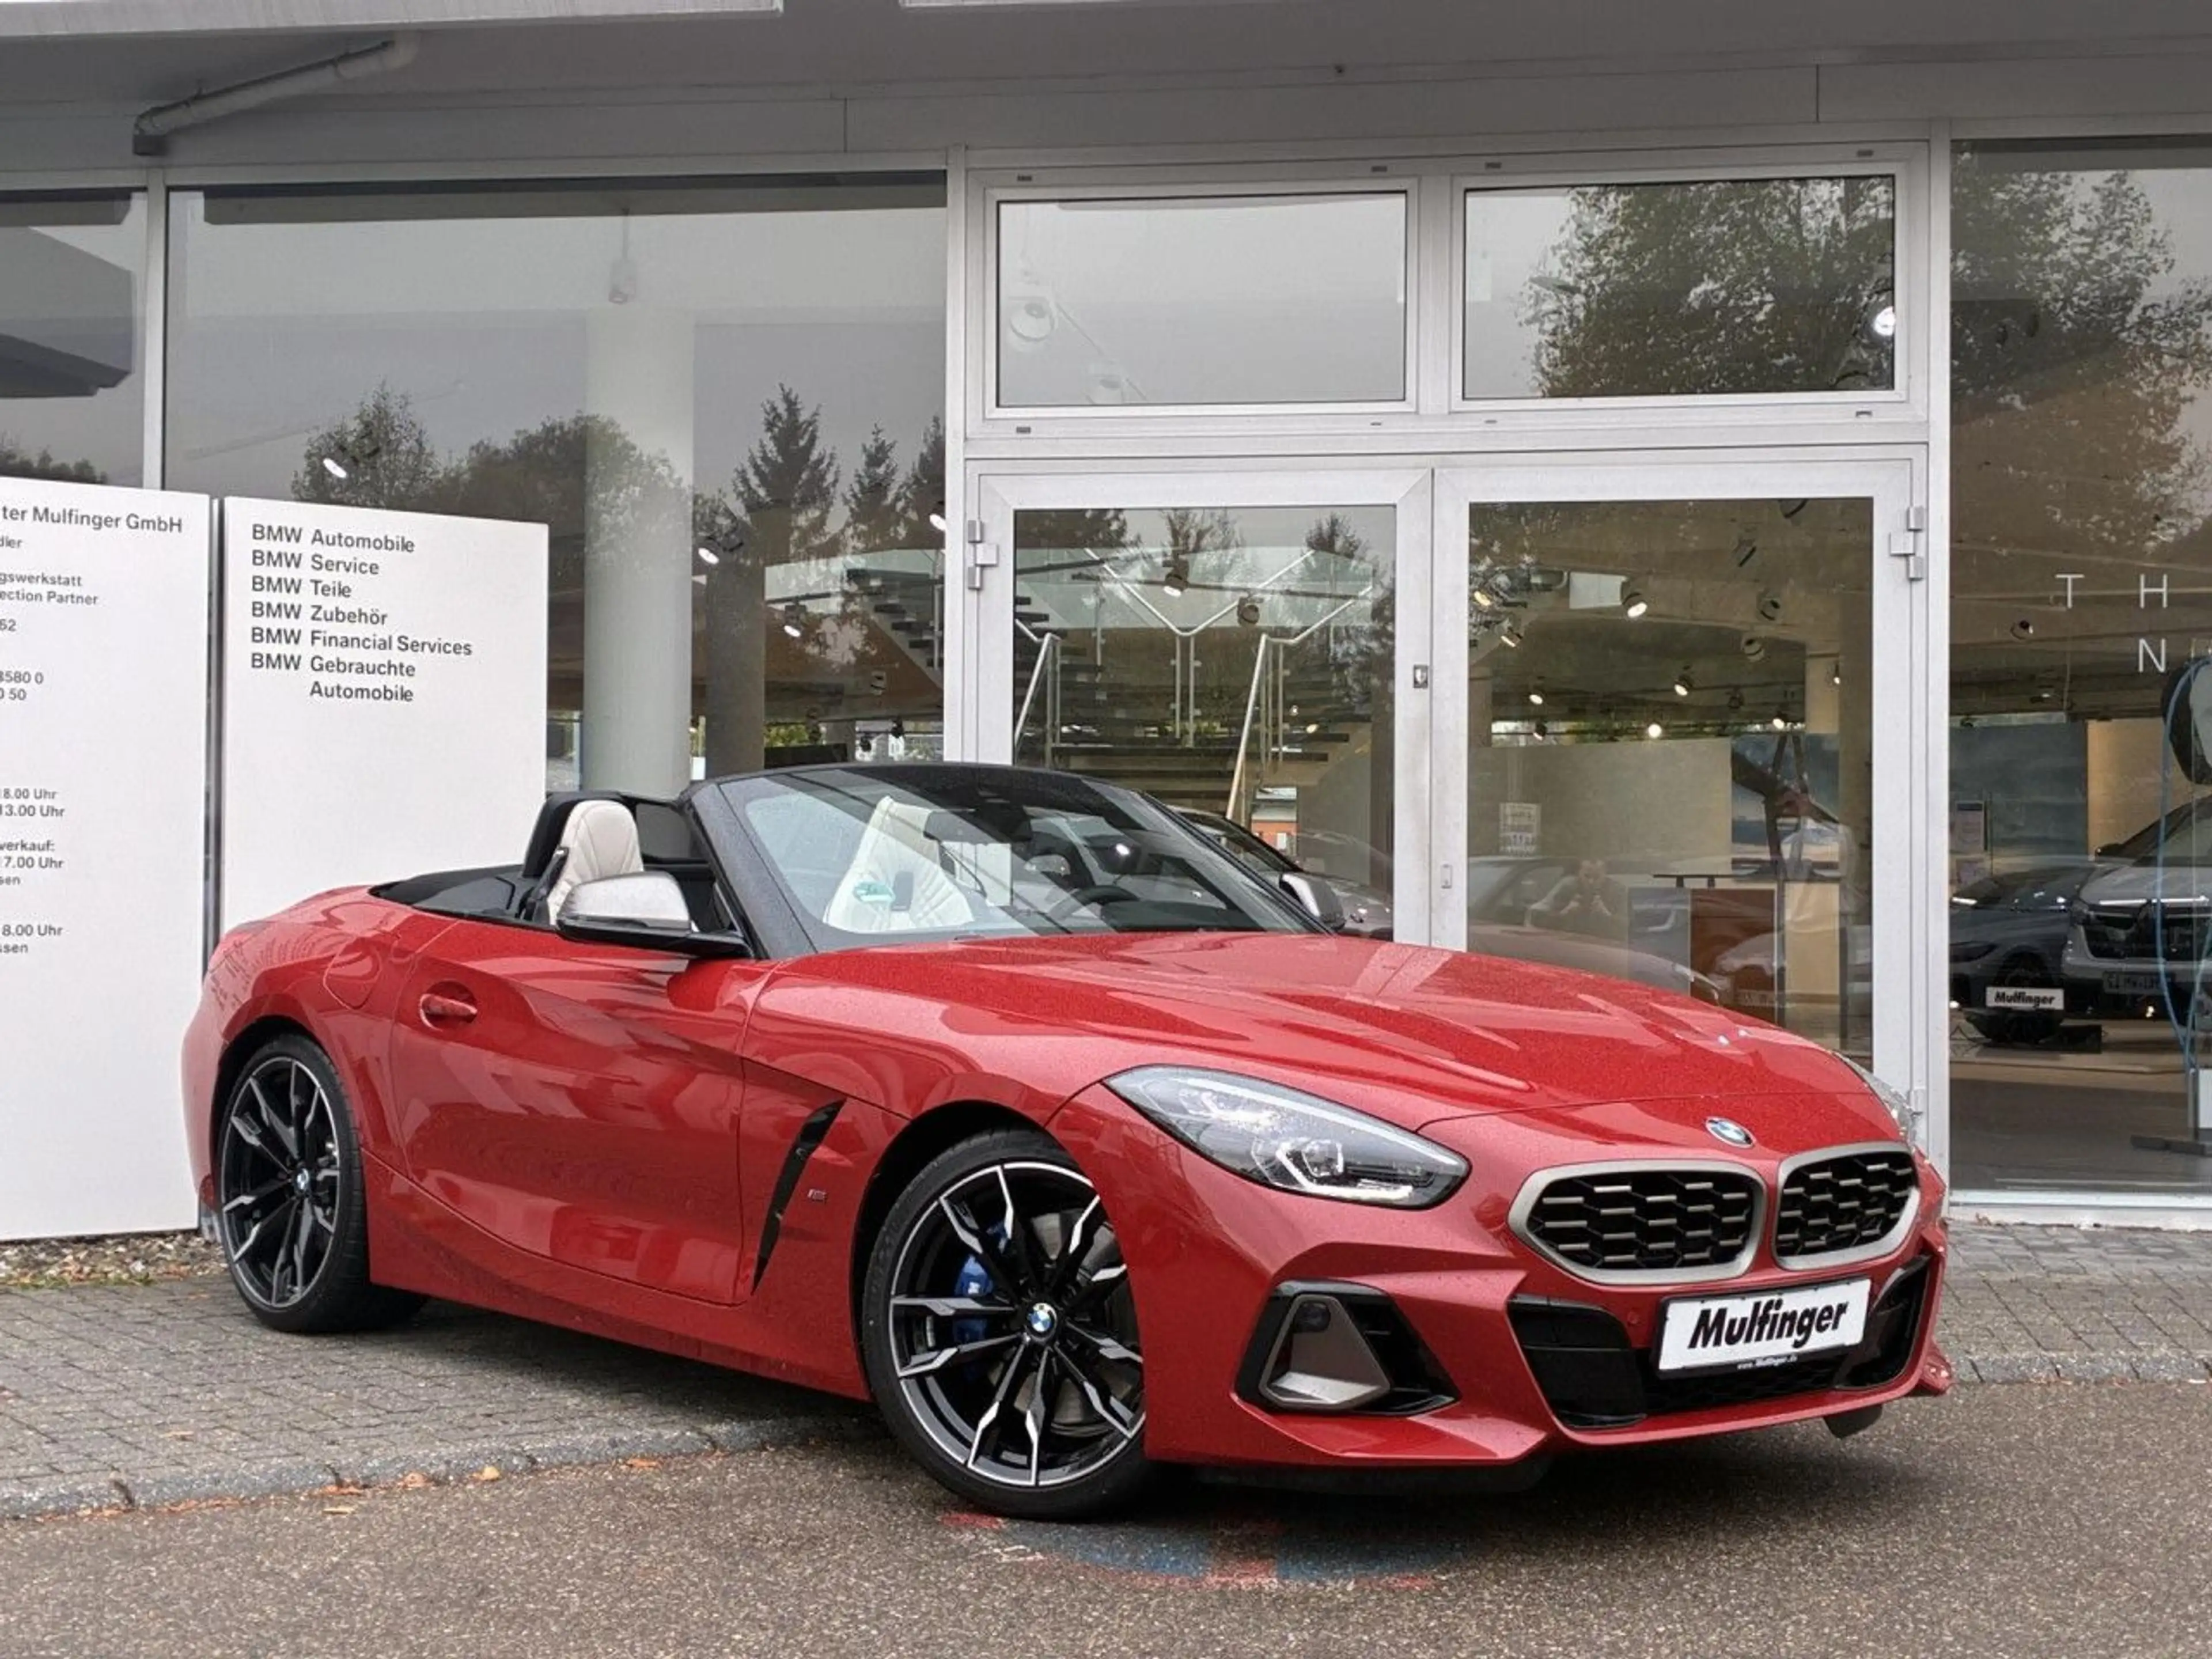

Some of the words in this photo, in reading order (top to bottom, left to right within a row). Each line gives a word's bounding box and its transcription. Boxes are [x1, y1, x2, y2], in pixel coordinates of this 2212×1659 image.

[2, 506, 26, 520] ter
[33, 507, 120, 530] Mulfinger
[126, 514, 181, 532] GmbH
[253, 524, 302, 543] BMW
[312, 529, 414, 552] Automobile
[252, 550, 302, 569] BMW
[312, 554, 378, 574] Service
[47, 591, 97, 604] Partner
[252, 575, 301, 594] BMW
[310, 579, 351, 598] Teile
[252, 601, 301, 619] BMW
[311, 605, 387, 625] Zubehör
[252, 627, 301, 645] BMW
[311, 630, 392, 650] Financial
[397, 635, 472, 656] Services
[252, 653, 301, 671] BMW
[310, 656, 415, 677] Gebrauchte
[2138, 638, 2166, 673] N
[35, 673, 43, 684] 0
[9, 688, 26, 700] 50
[310, 681, 413, 702] Automobile
[35, 790, 56, 799] Uhr
[40, 806, 64, 816] Uhr
[39, 858, 63, 868] Uhr
[38, 925, 62, 936] Uhr
[1995, 991, 2054, 1006] Mulfinger
[1687, 1298, 1848, 1349] Mulfinger
